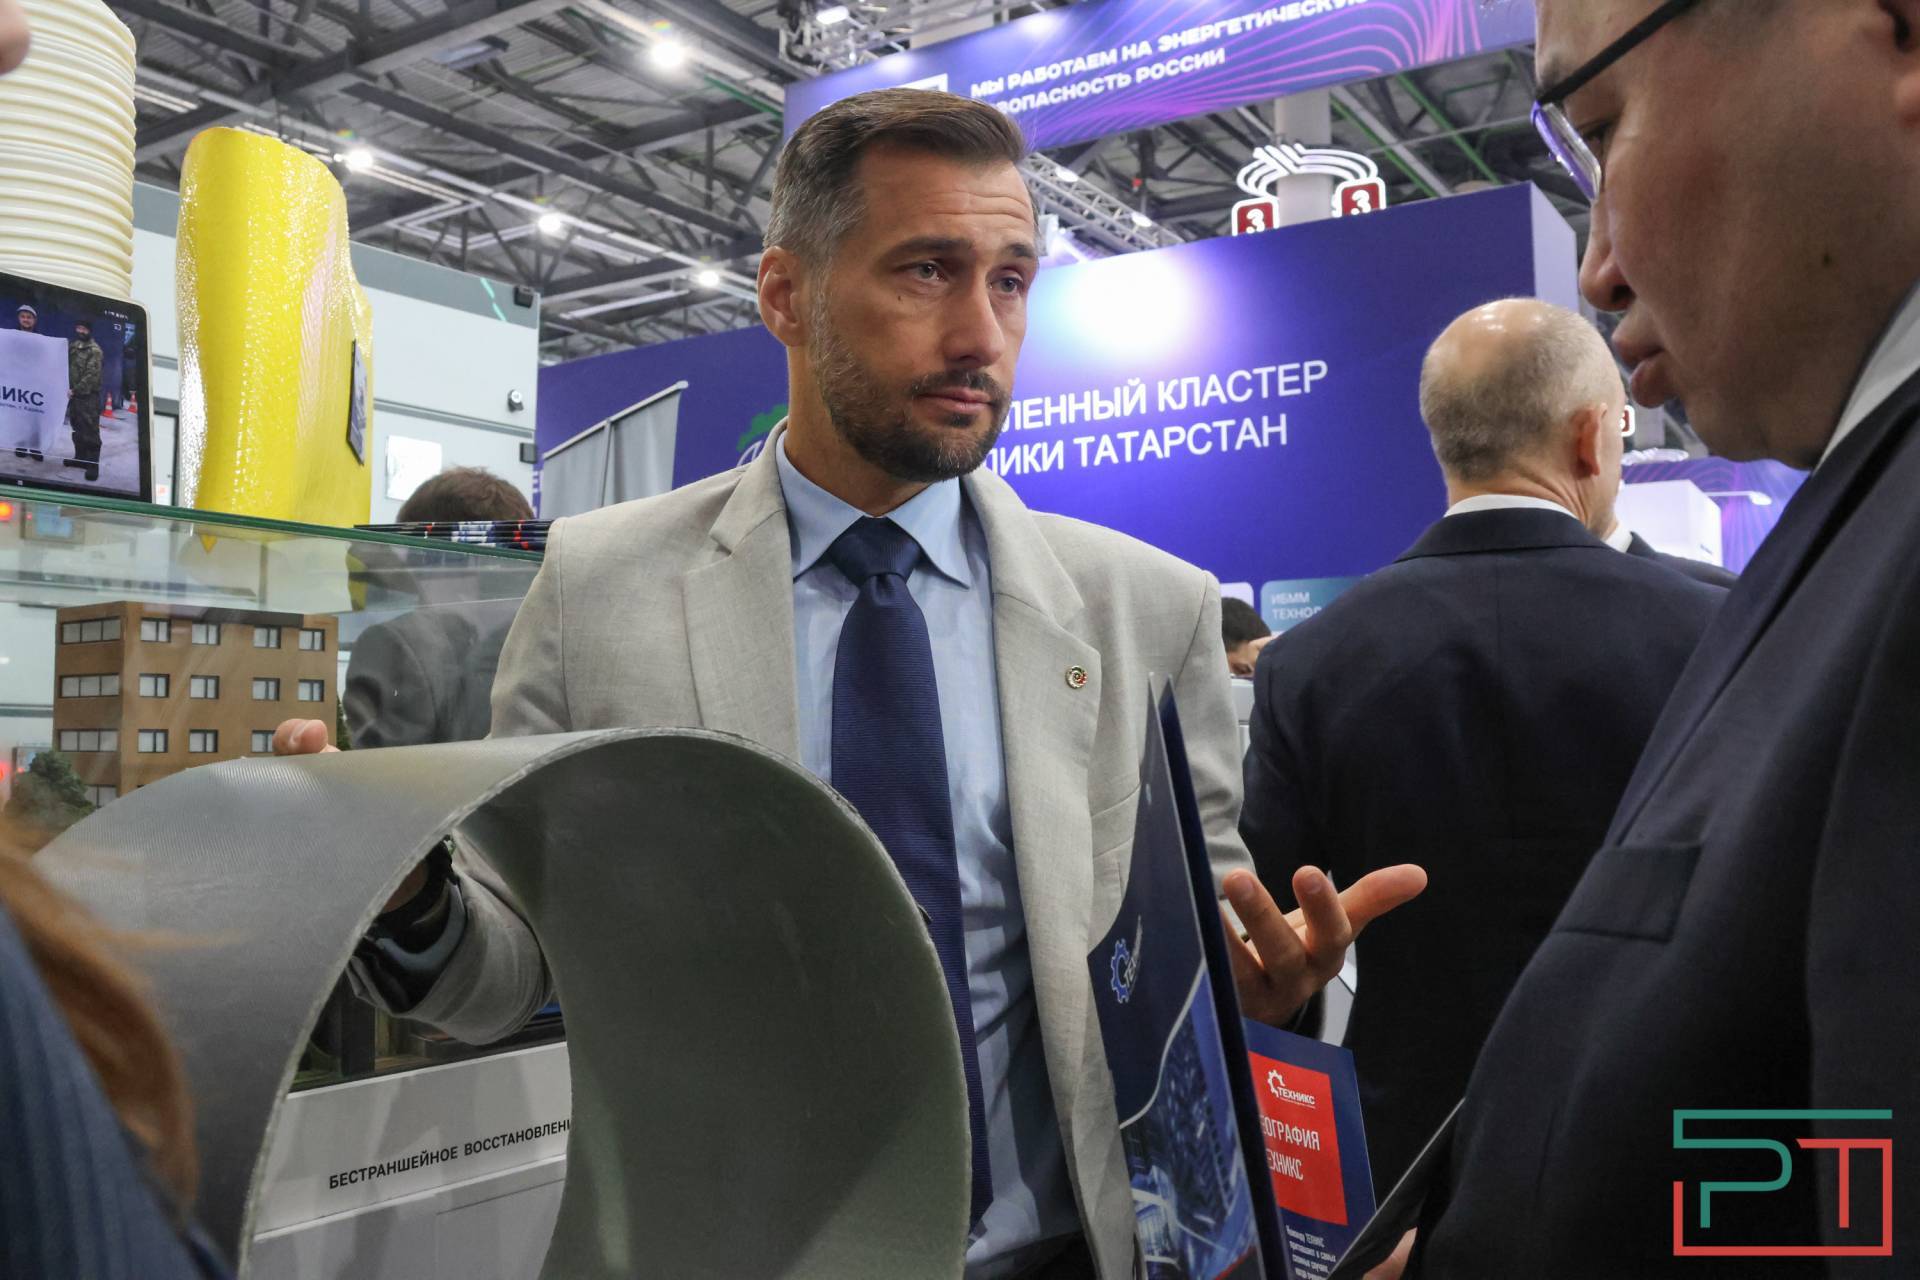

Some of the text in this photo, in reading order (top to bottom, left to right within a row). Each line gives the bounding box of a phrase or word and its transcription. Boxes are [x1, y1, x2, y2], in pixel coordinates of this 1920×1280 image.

[970, 77, 1004, 98] МЫ
[1007, 48, 1118, 90] РАБОТАЕМ
[1121, 41, 1153, 63] НА
[994, 48, 1226, 115] ЗОПАСНОСТЬ РОССИИ
[1157, 360, 1328, 412] КЛАСТЕР
[1073, 413, 1288, 468] ТАТАРСТАН
[1277, 1086, 1316, 1105] ТЕХНИКС
[329, 1146, 459, 1190] БЕСТРАНШЕЙНОЕ
